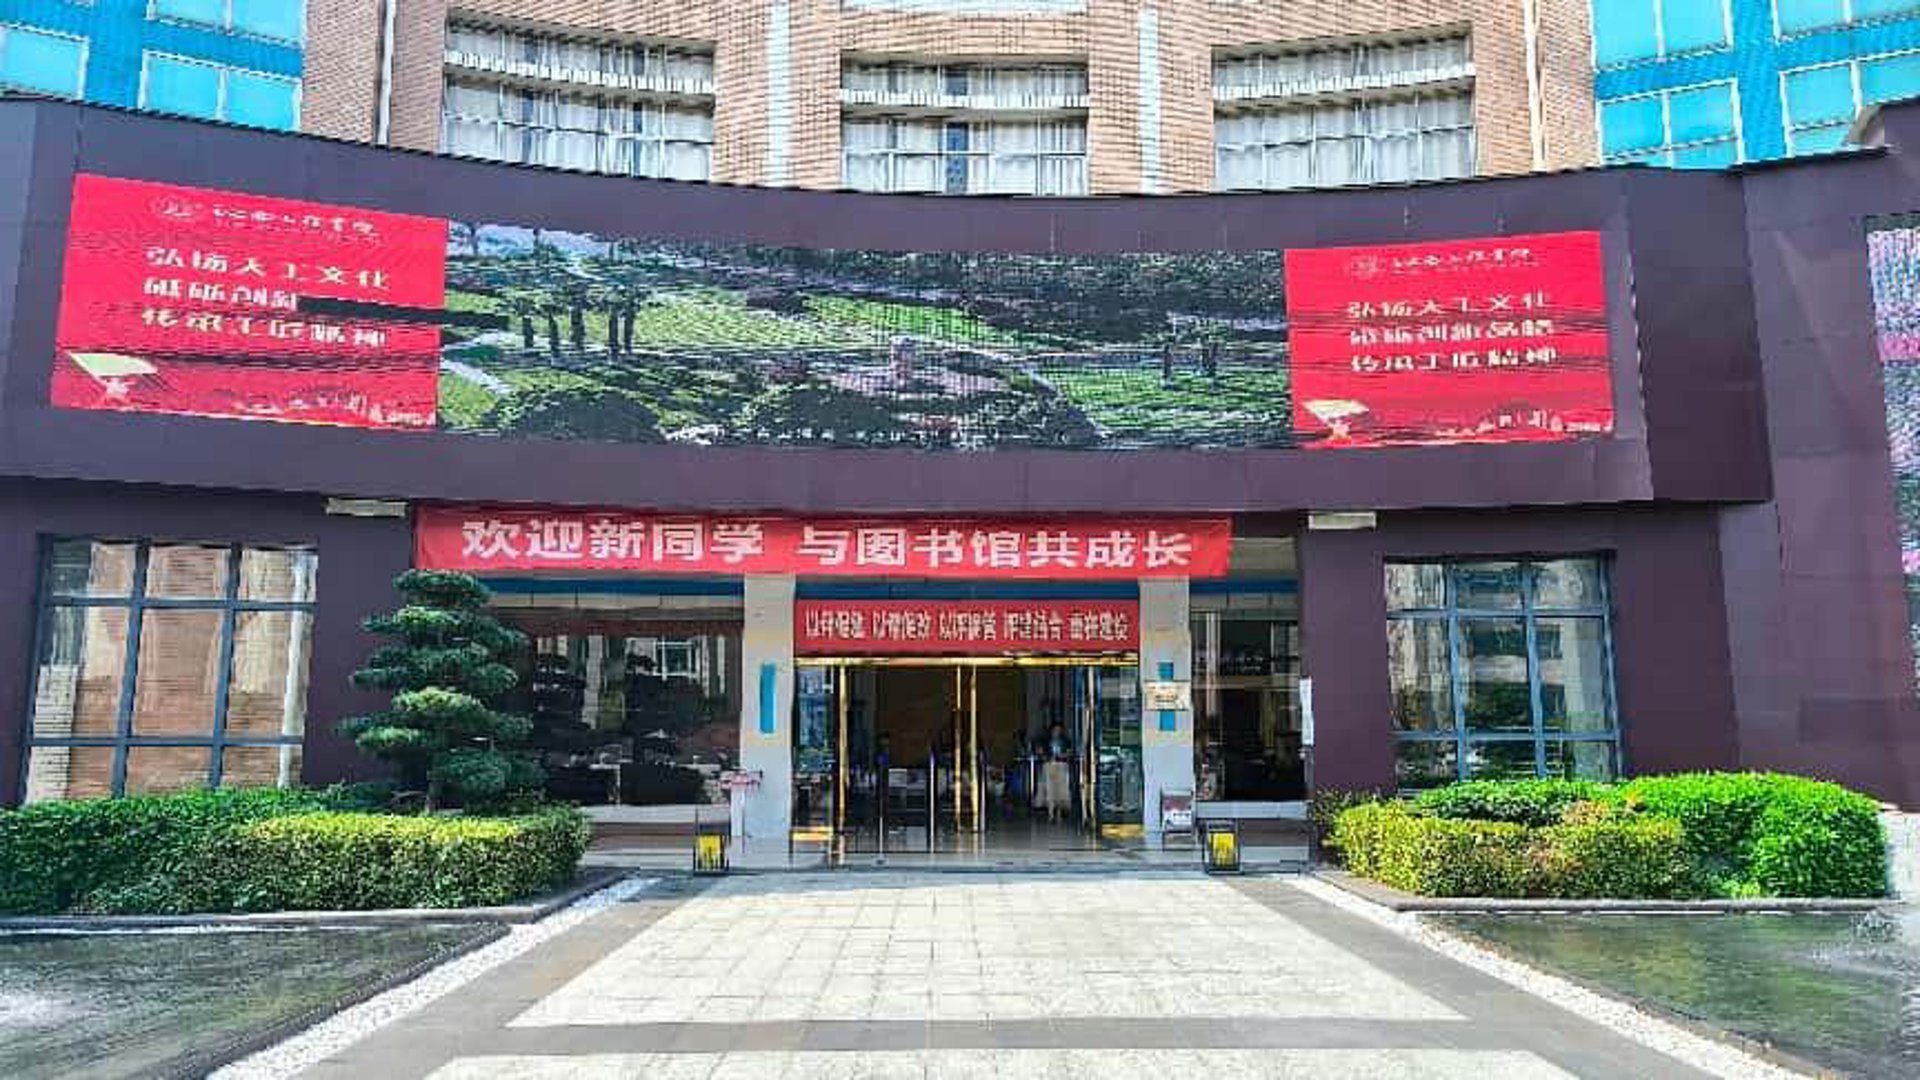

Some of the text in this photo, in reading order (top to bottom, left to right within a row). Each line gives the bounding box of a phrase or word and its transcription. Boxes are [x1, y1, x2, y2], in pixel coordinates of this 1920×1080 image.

[461, 518, 1193, 568] 欢迎新同学 与图书馆共成长
